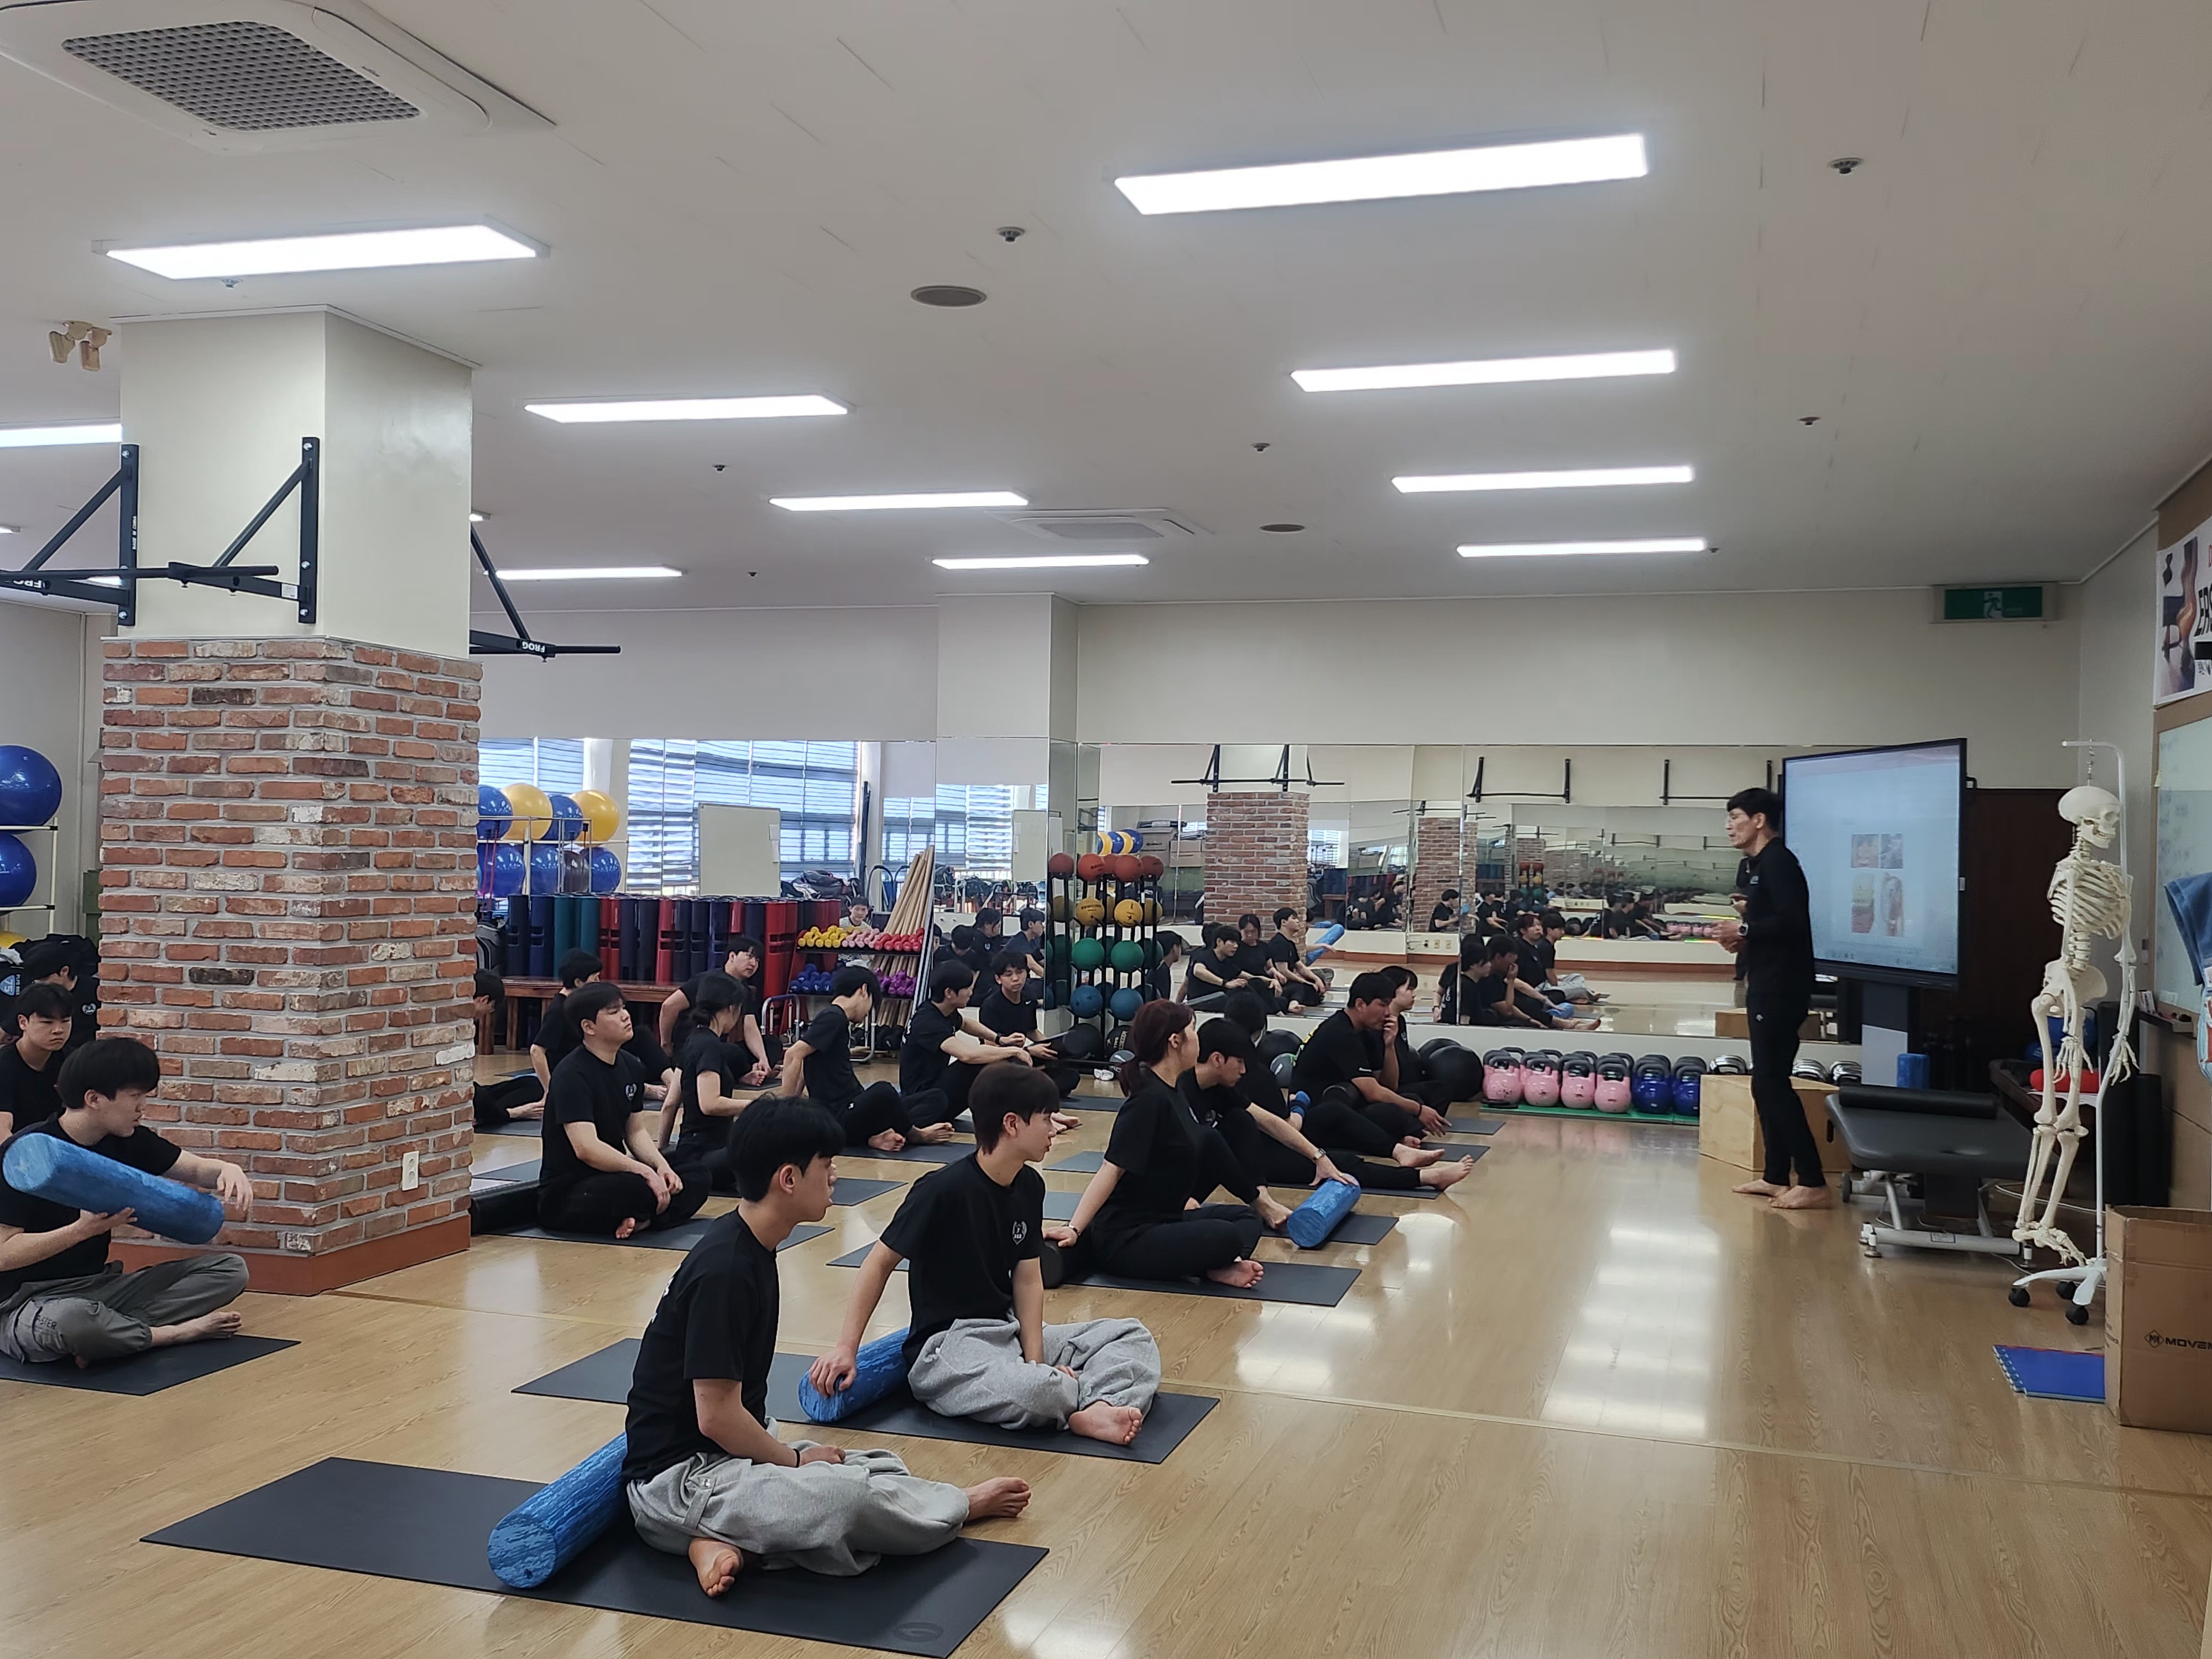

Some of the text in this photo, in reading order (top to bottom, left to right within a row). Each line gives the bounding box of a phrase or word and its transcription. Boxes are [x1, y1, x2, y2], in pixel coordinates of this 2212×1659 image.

[13, 580, 42, 588] FR
[521, 641, 545, 653] FROG
[4, 979, 13, 992] 75
[1118, 1030, 1128, 1050] MEDICI
